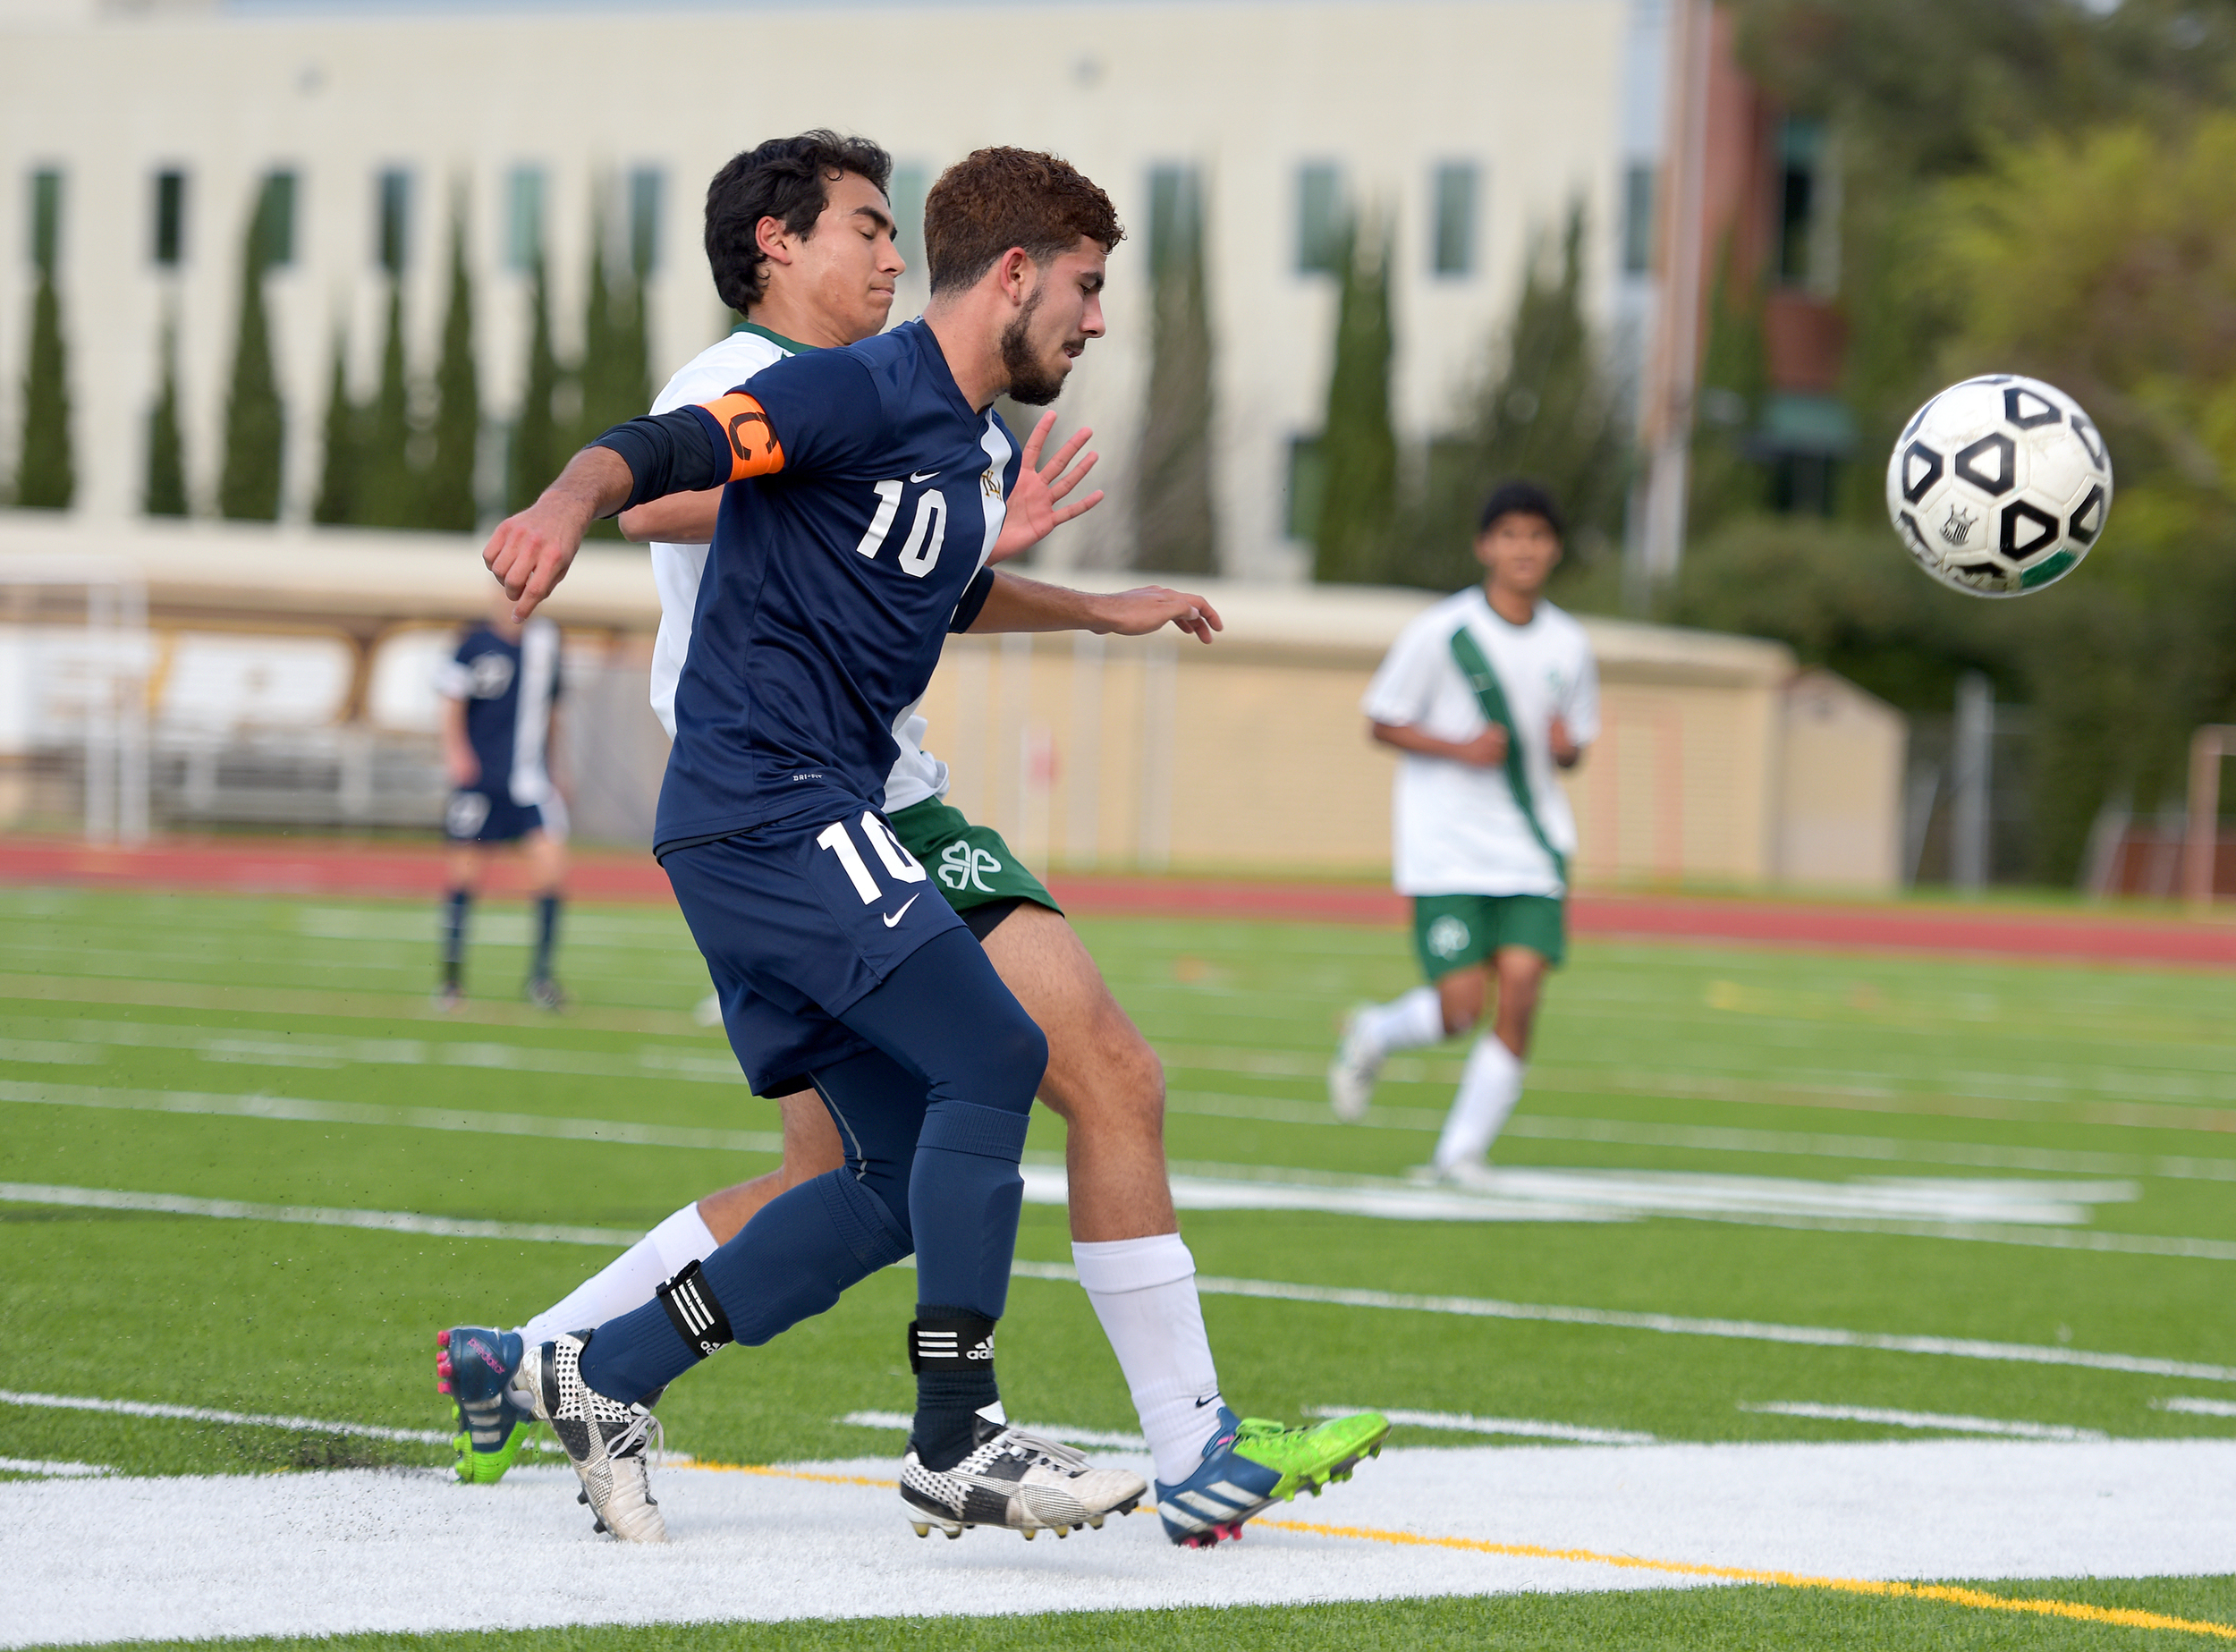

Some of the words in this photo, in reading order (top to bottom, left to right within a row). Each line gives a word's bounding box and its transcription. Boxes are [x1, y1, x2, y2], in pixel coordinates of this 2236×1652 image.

[729, 411, 778, 461] C
[857, 479, 947, 578] 10
[816, 810, 927, 905] 10
[467, 1337, 505, 1375] predator
